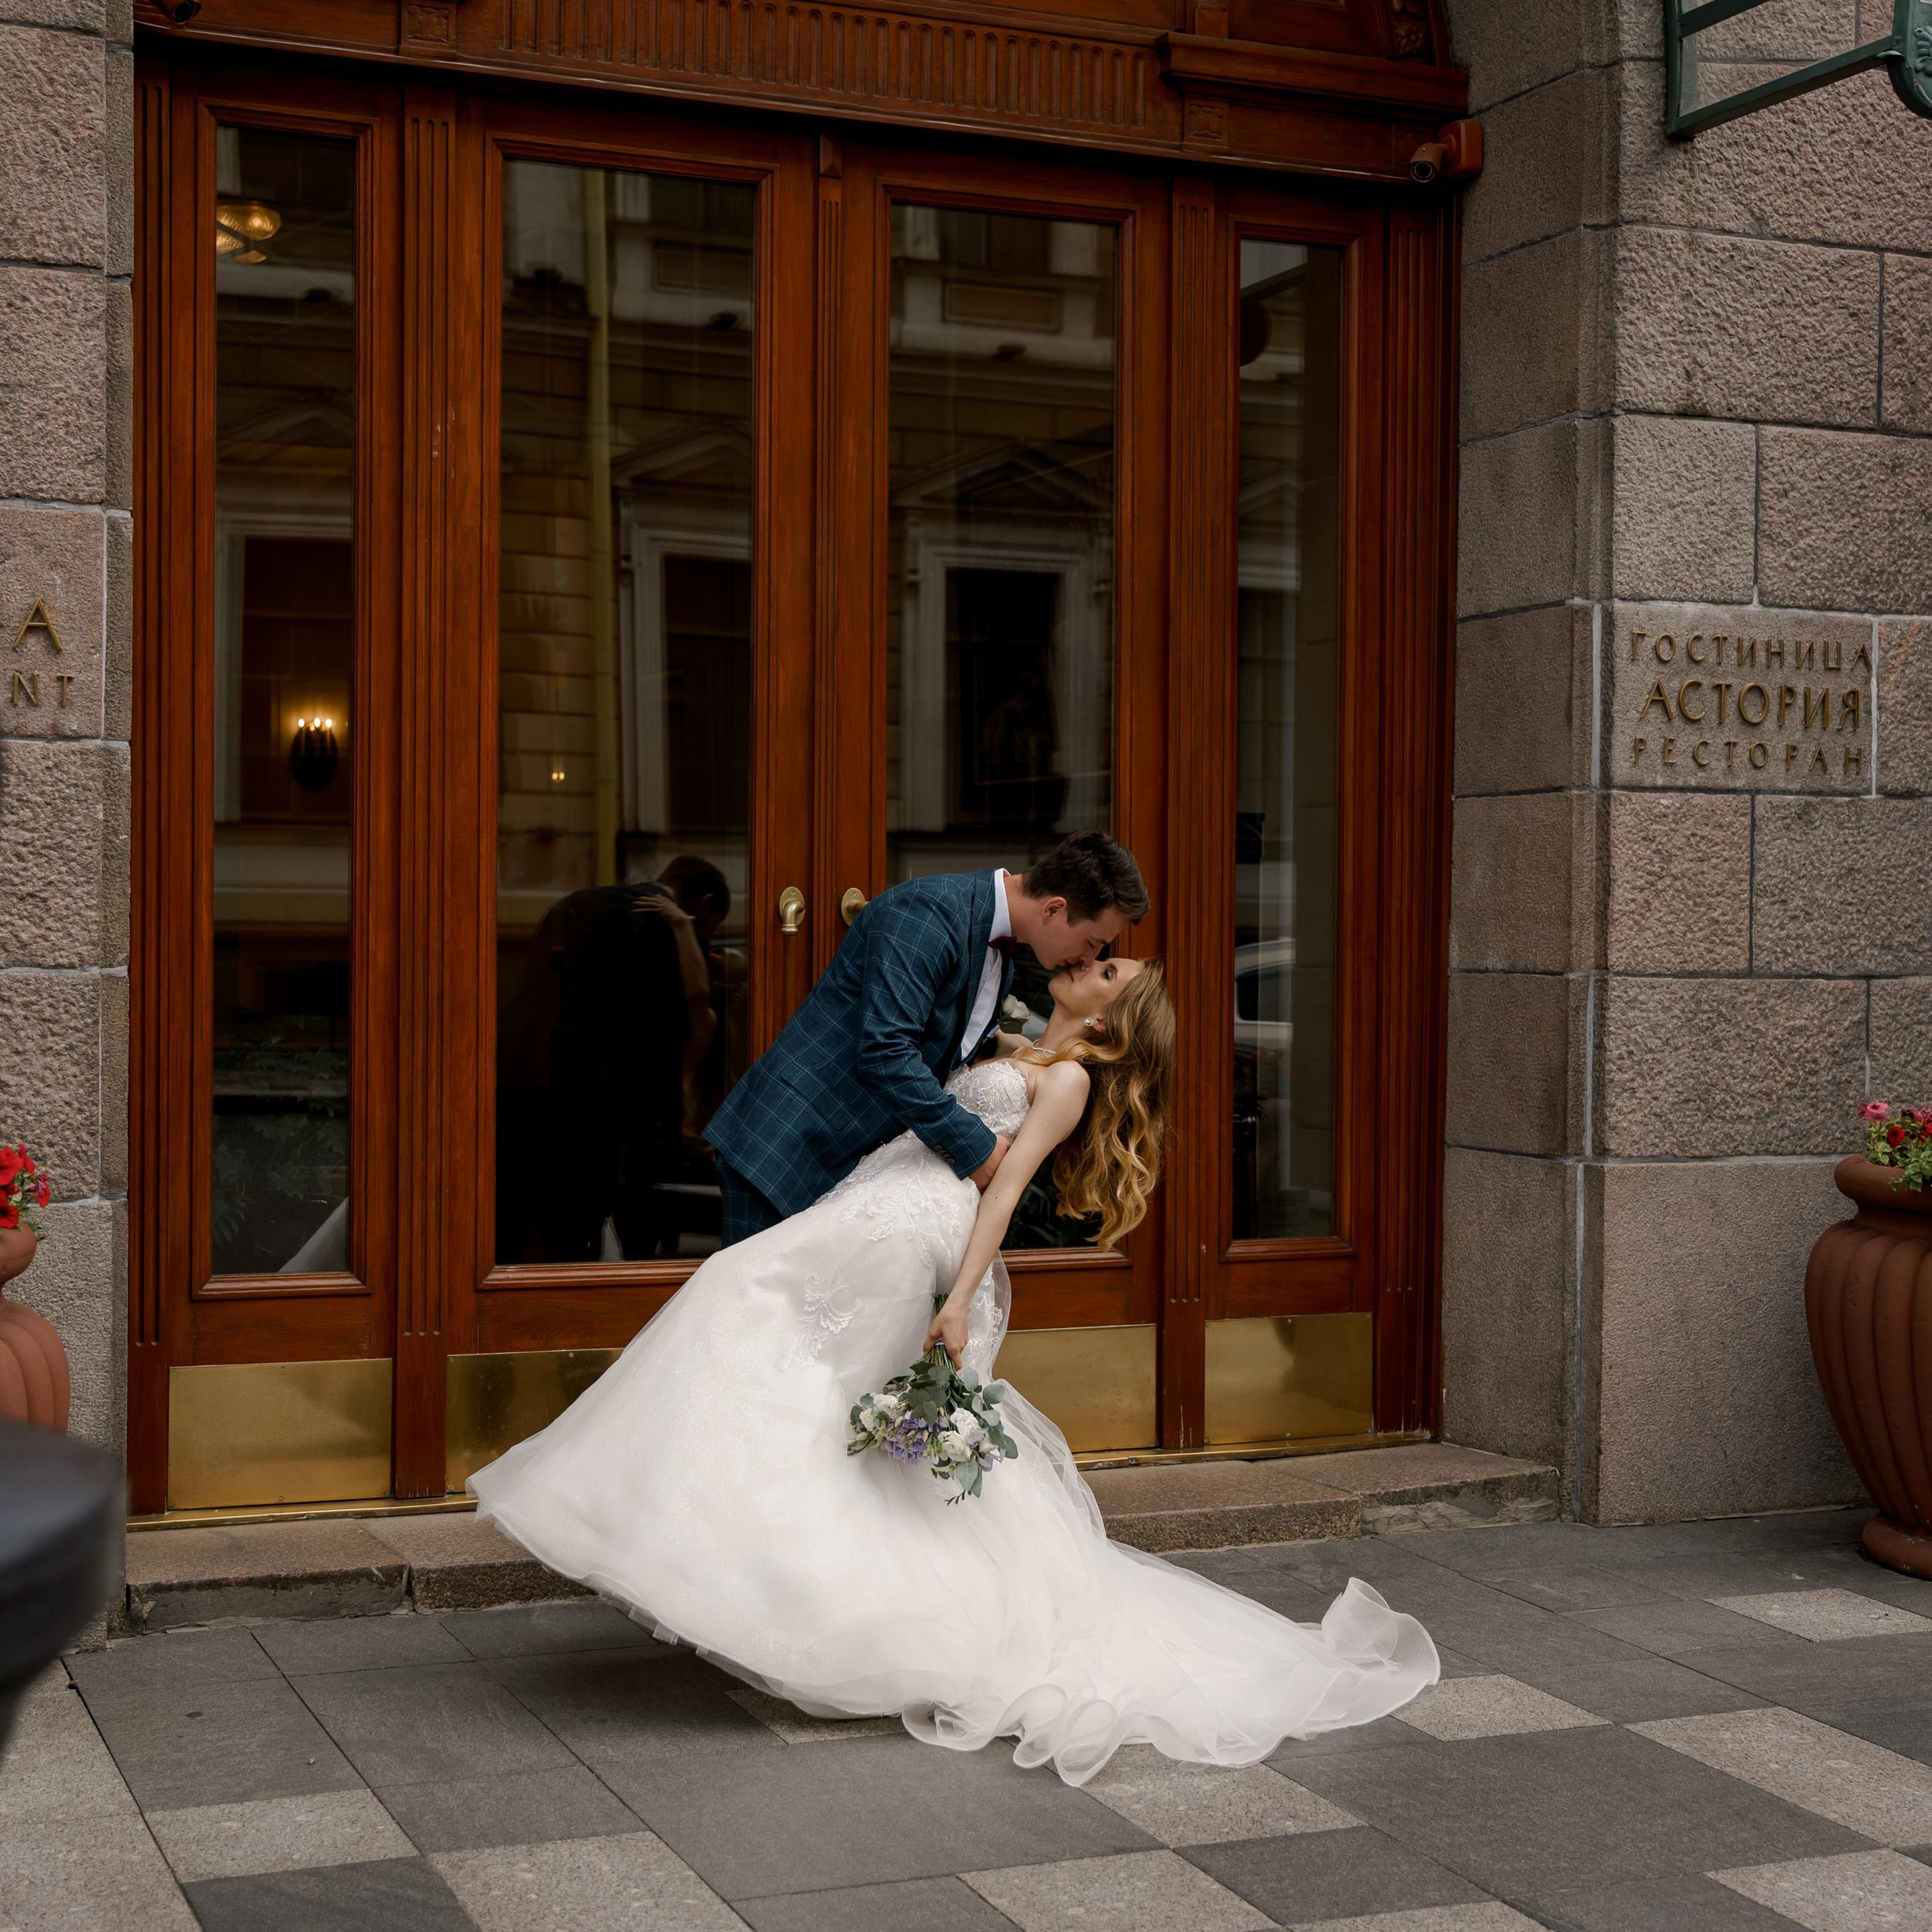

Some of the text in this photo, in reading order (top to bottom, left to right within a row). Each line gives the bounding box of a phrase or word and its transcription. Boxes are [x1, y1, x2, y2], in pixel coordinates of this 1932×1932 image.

[1630, 631, 1872, 672] ГОСТИНИЦА
[1640, 678, 1860, 731] АСТОРИЯ
[1630, 736, 1863, 774] РЕСТОРАН
